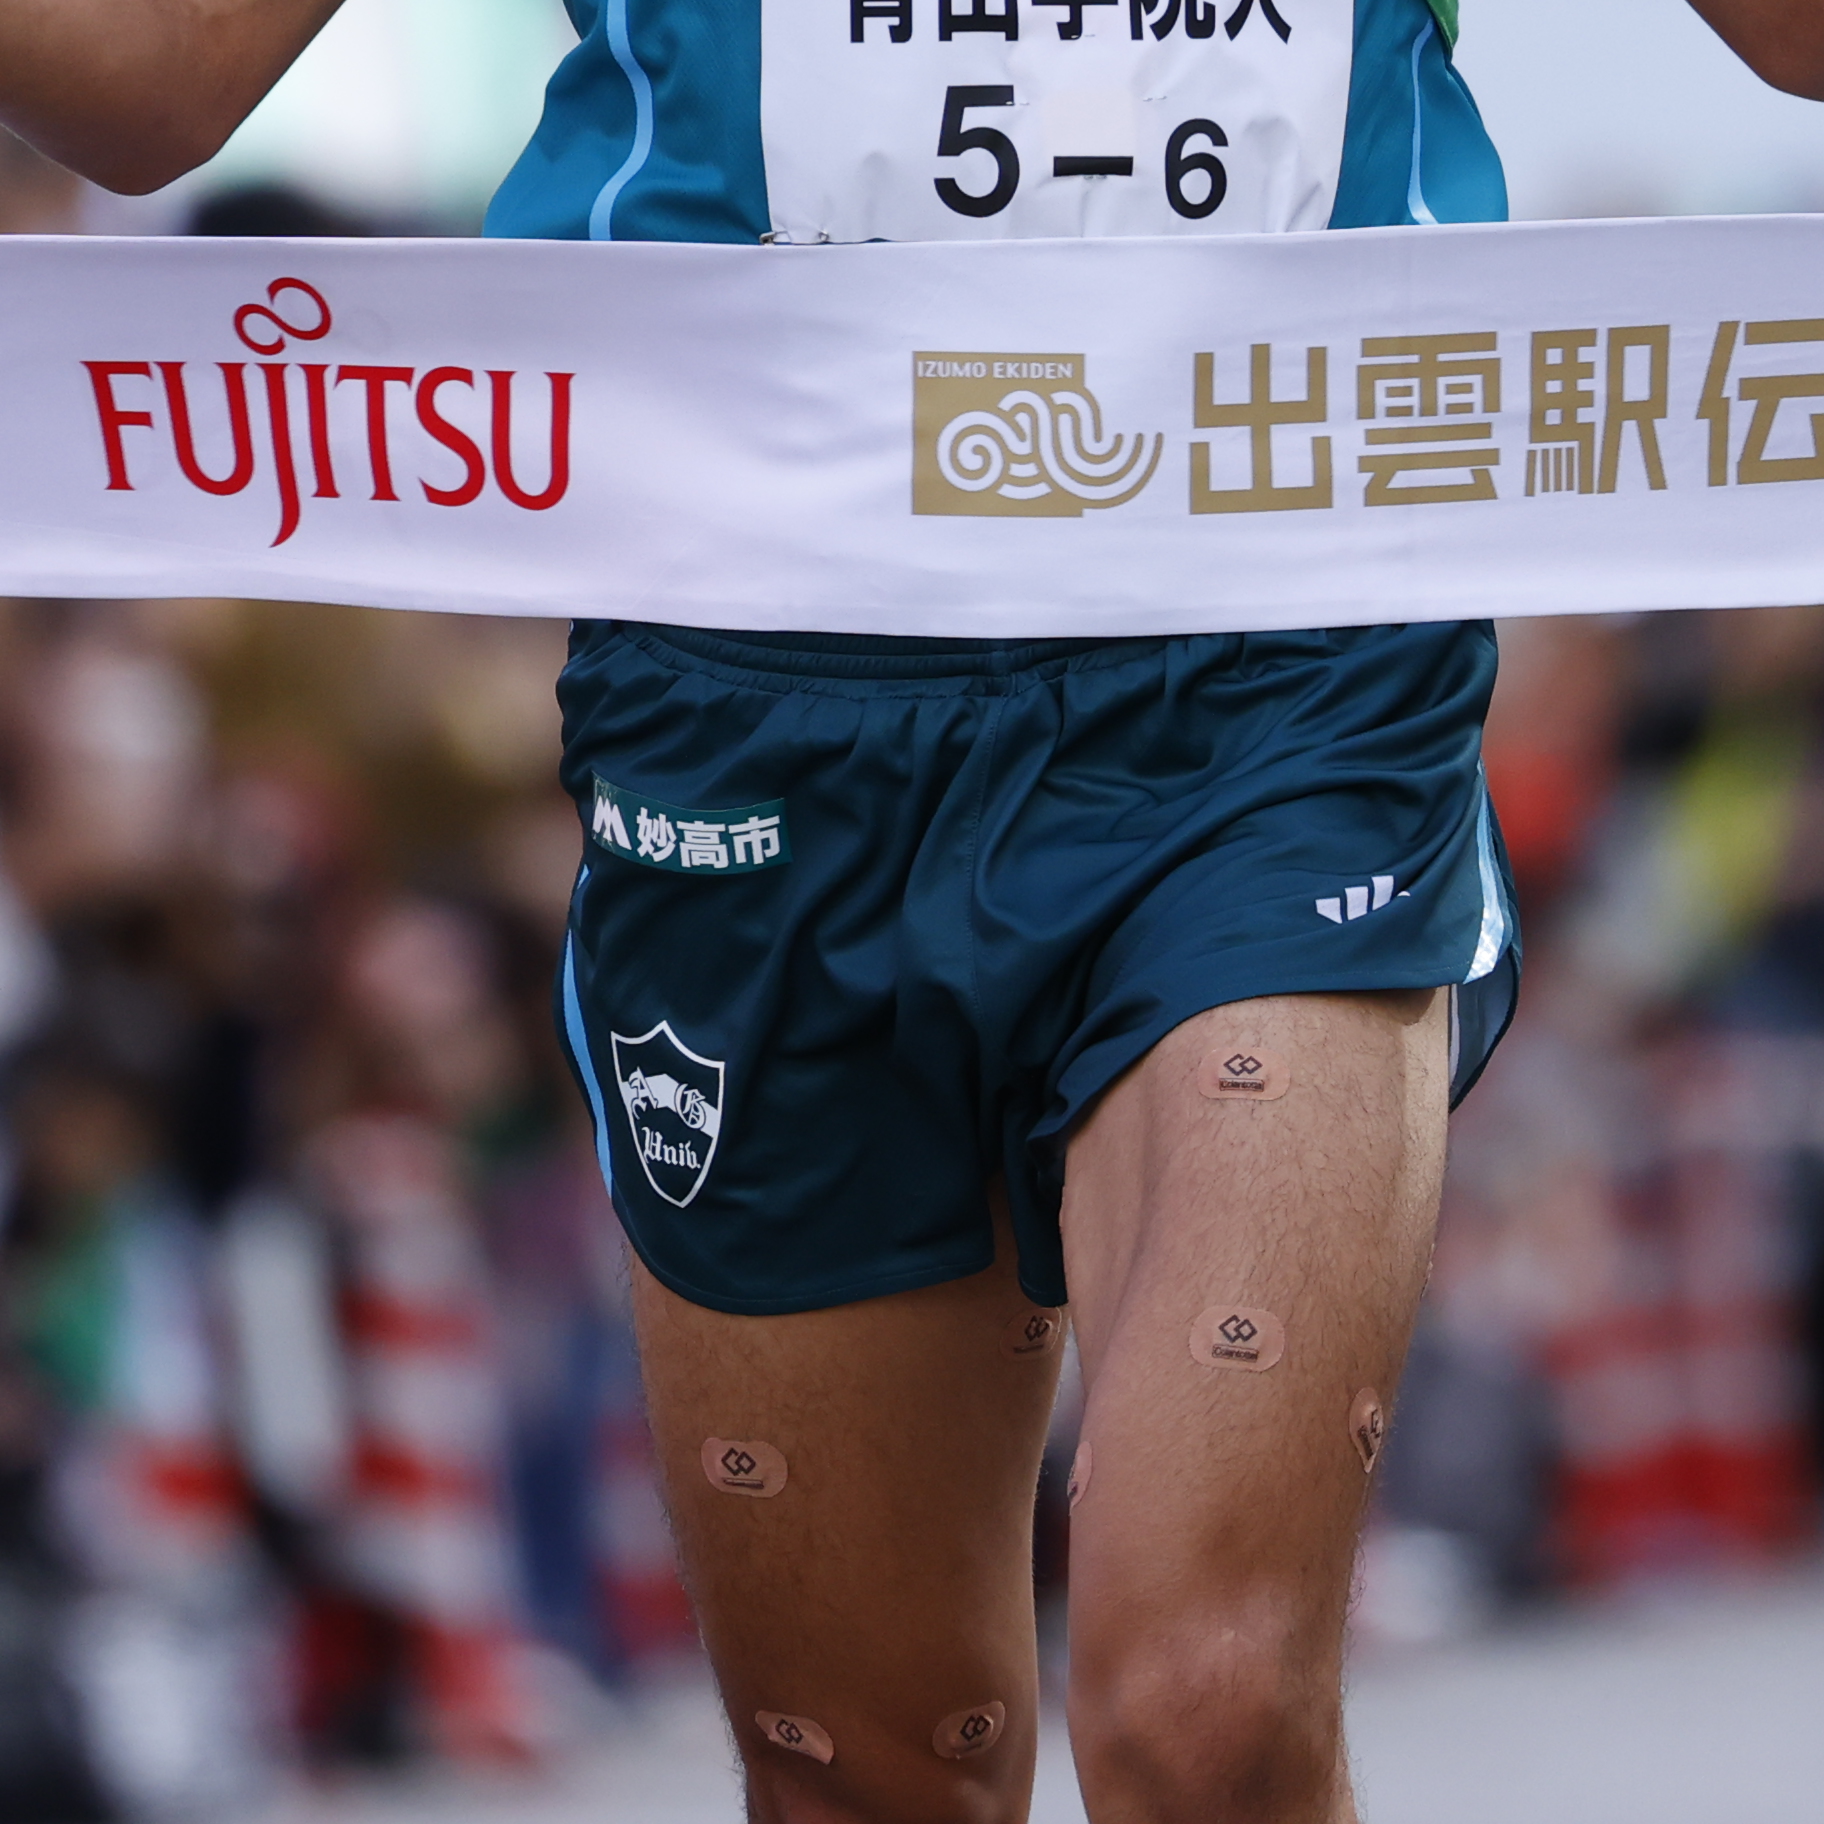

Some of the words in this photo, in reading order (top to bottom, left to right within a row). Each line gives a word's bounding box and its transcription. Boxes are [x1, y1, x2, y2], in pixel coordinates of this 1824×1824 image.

[916, 360, 988, 379] IZUMO
[992, 361, 1074, 380] EKIDEN
[80, 276, 576, 549] FUJITSU
[636, 806, 781, 869] 妙高市
[640, 1126, 702, 1170] Univ.
